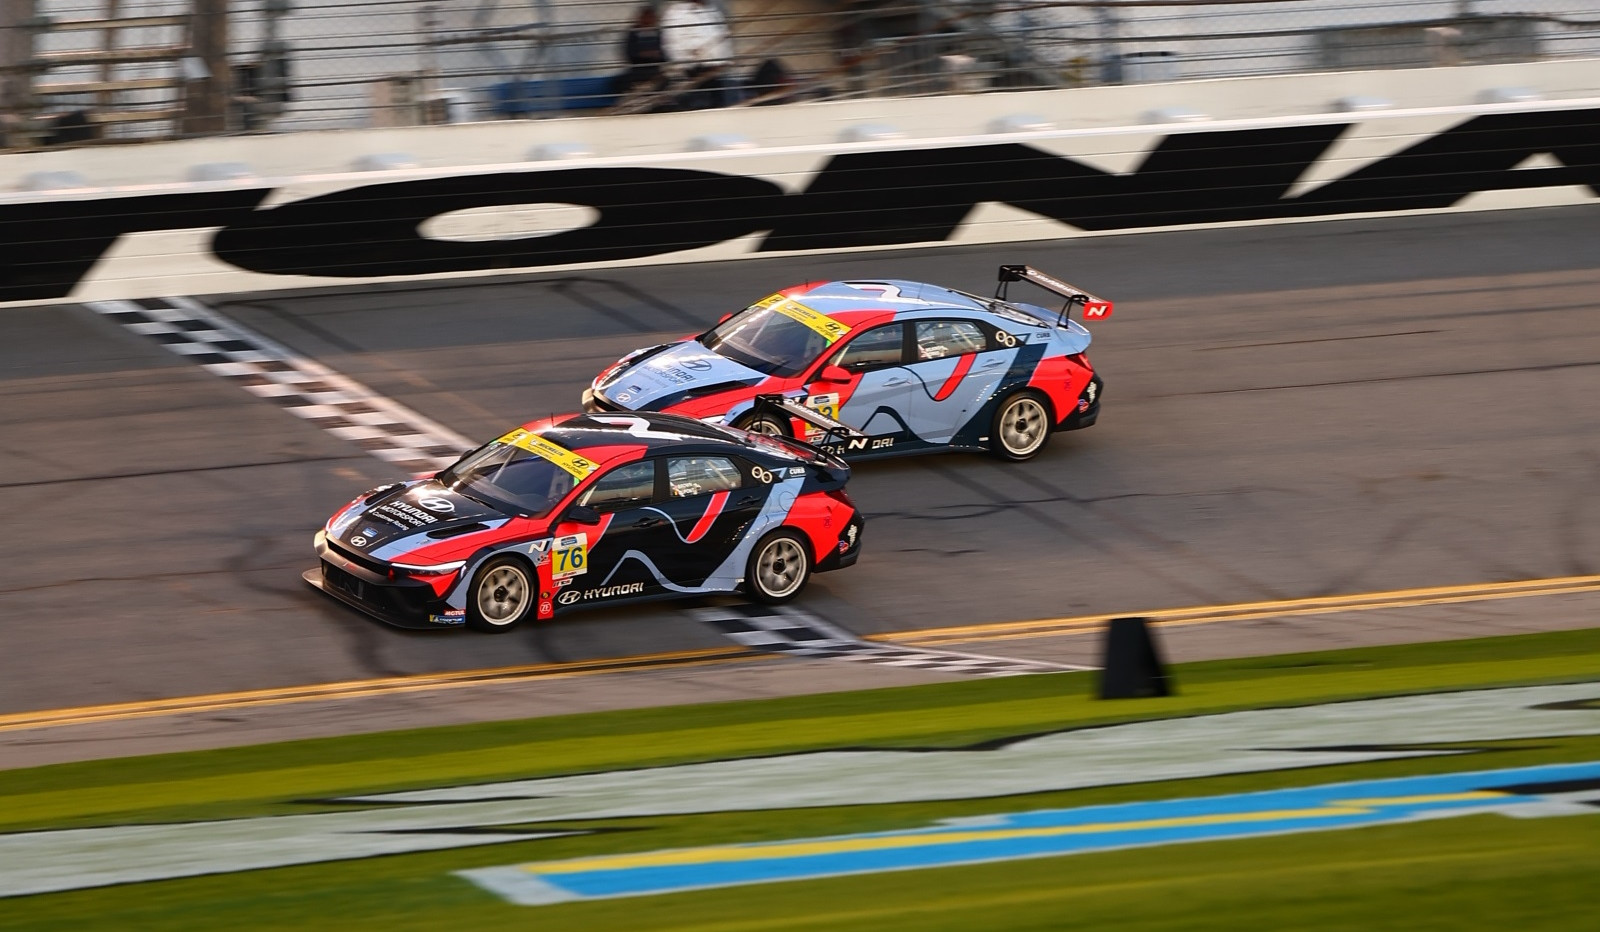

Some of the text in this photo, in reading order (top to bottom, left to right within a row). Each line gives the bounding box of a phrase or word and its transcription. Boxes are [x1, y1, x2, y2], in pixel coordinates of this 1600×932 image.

[1087, 305, 1107, 316] N
[848, 438, 868, 449] N
[372, 511, 410, 531] Customer Racing
[379, 505, 426, 527] MOTORSPORT
[389, 500, 439, 524] HYUNDAI
[528, 540, 550, 554] N
[557, 547, 583, 571] 76
[583, 582, 644, 600] HYUNDAI
